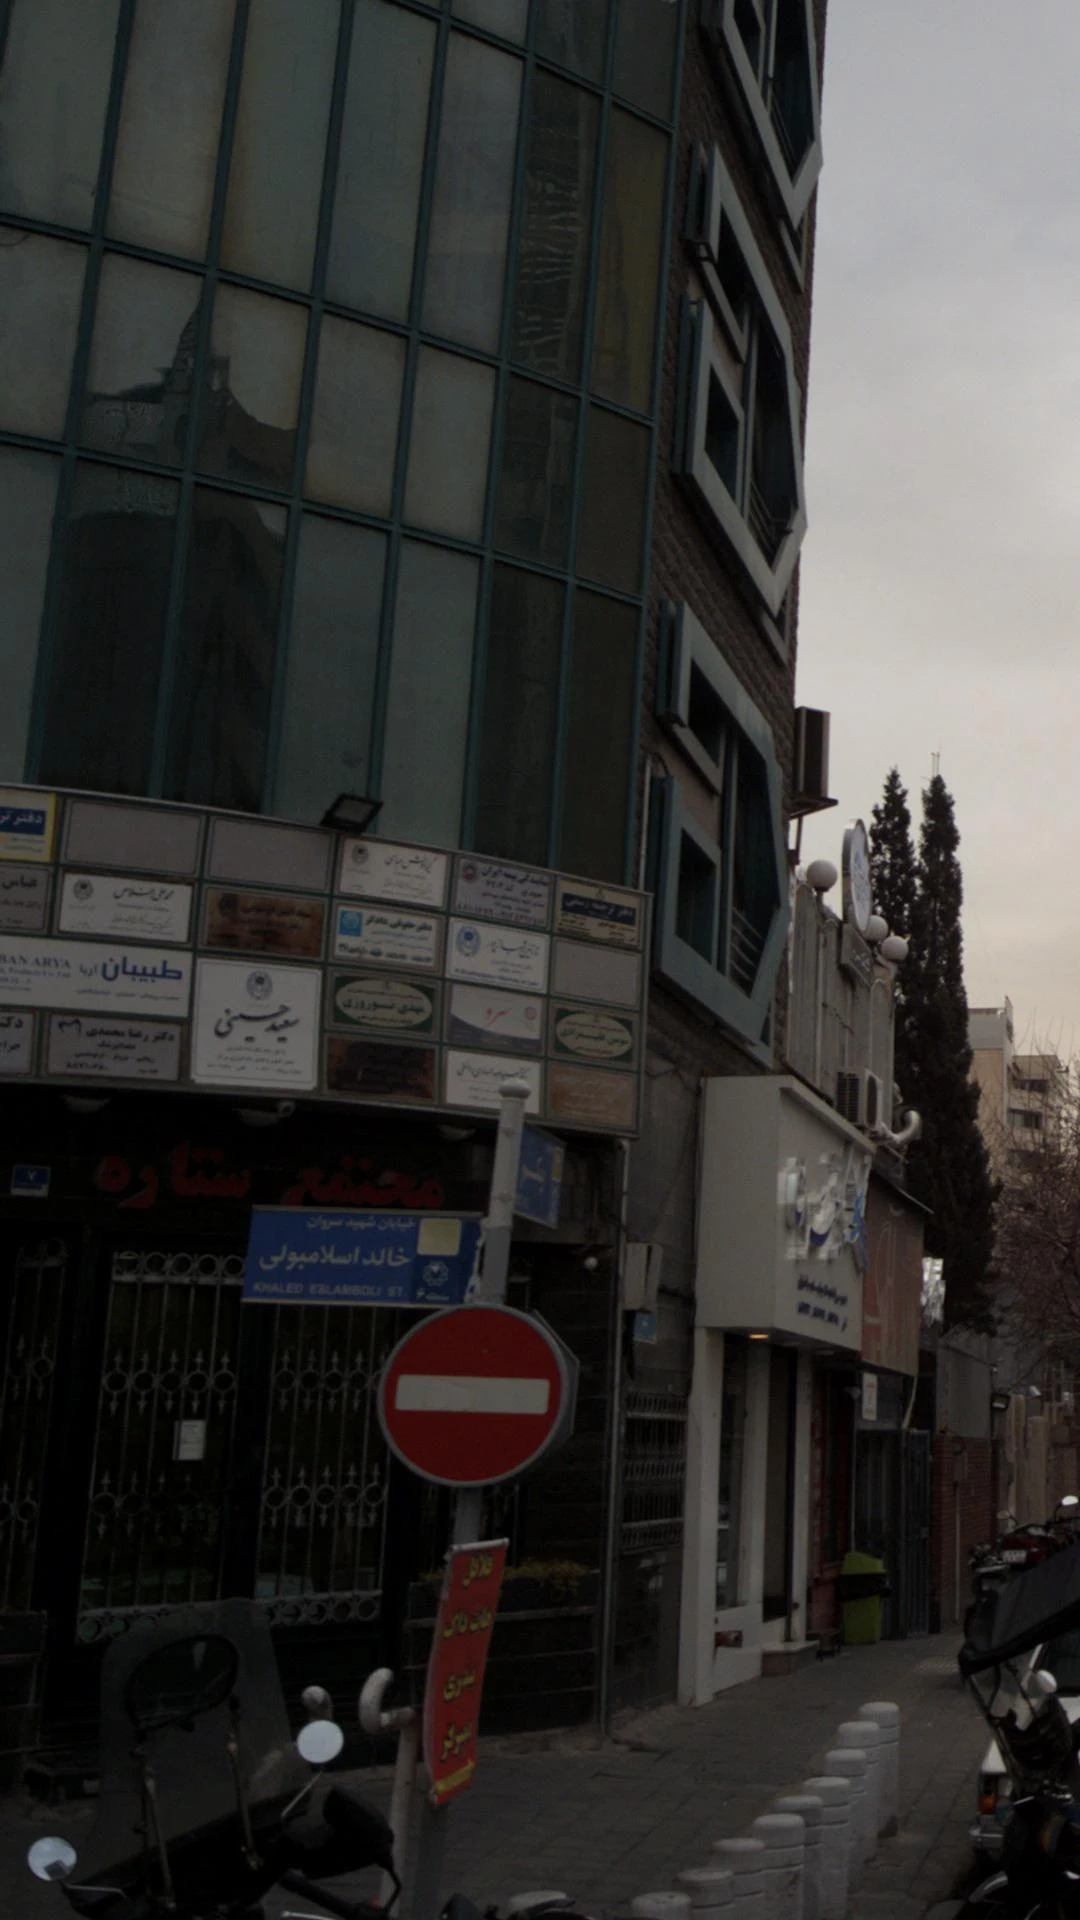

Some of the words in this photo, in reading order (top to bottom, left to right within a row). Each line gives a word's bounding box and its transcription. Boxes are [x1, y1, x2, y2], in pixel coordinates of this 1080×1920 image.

[31, 956, 71, 969] ARYA
[102, 956, 183, 984] طبیبان
[214, 1004, 292, 1042] حسینی
[152, 1031, 175, 1043] دکتر
[96, 1139, 253, 1211] ستاره
[281, 1152, 446, 1208] مجتمع
[345, 1215, 377, 1230] شهید
[379, 1216, 417, 1231] خیابان
[258, 1243, 361, 1271] اسلامبولی
[363, 1245, 413, 1267] خالد
[253, 1282, 304, 1294] KHALED
[310, 1283, 382, 1297] ESLAMBOLI
